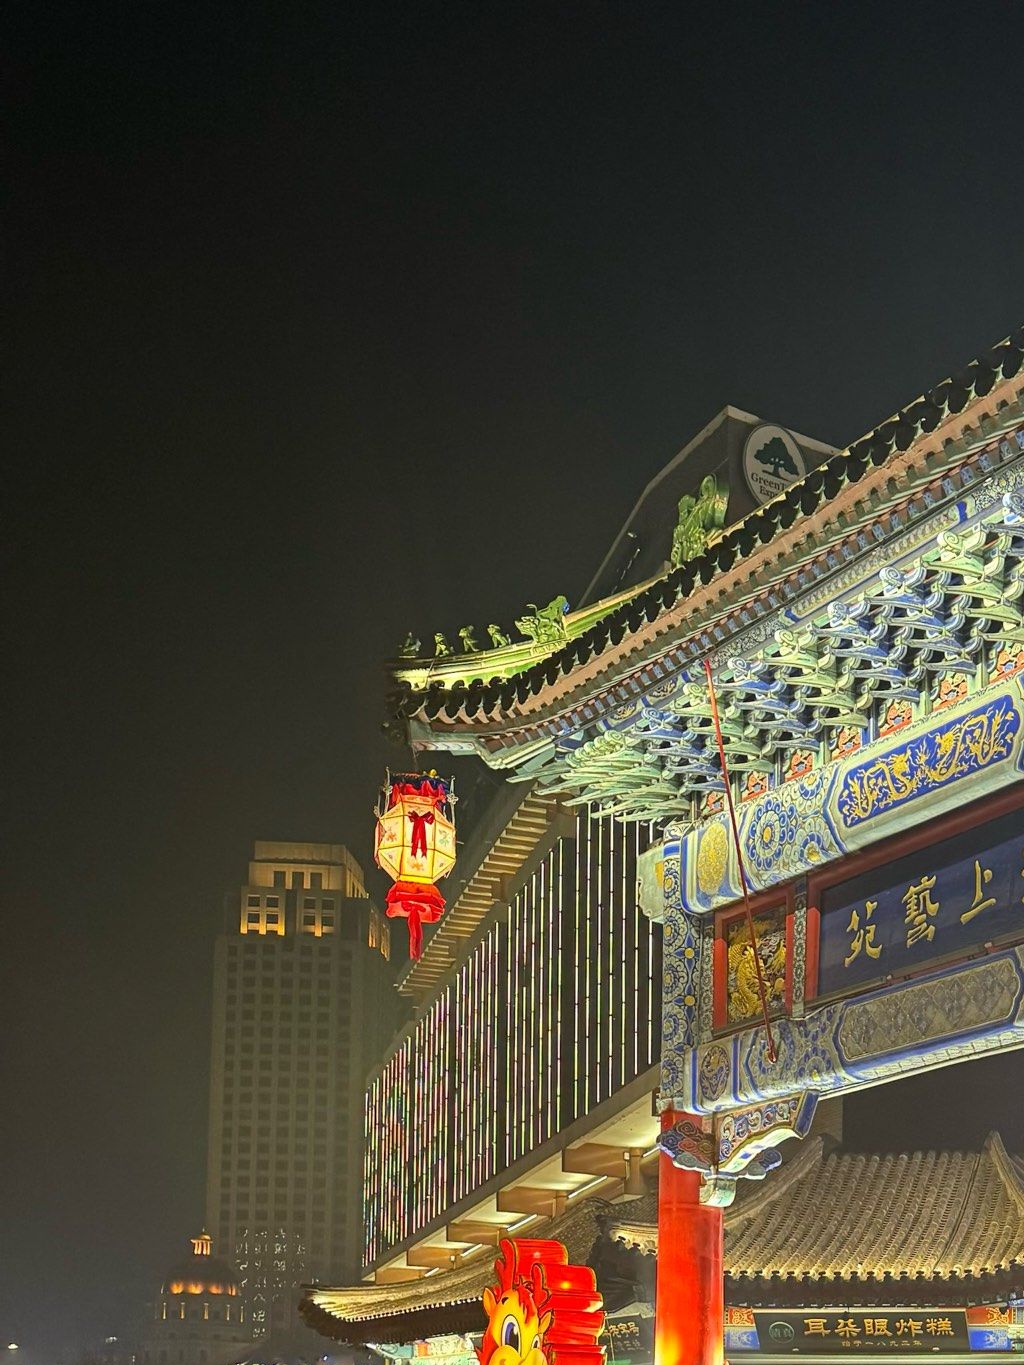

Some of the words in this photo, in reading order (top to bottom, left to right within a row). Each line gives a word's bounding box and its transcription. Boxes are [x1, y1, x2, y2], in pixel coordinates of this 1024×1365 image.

[751, 472, 785, 491] GreenT
[803, 1317, 955, 1338] 耳朵眼炸糕
